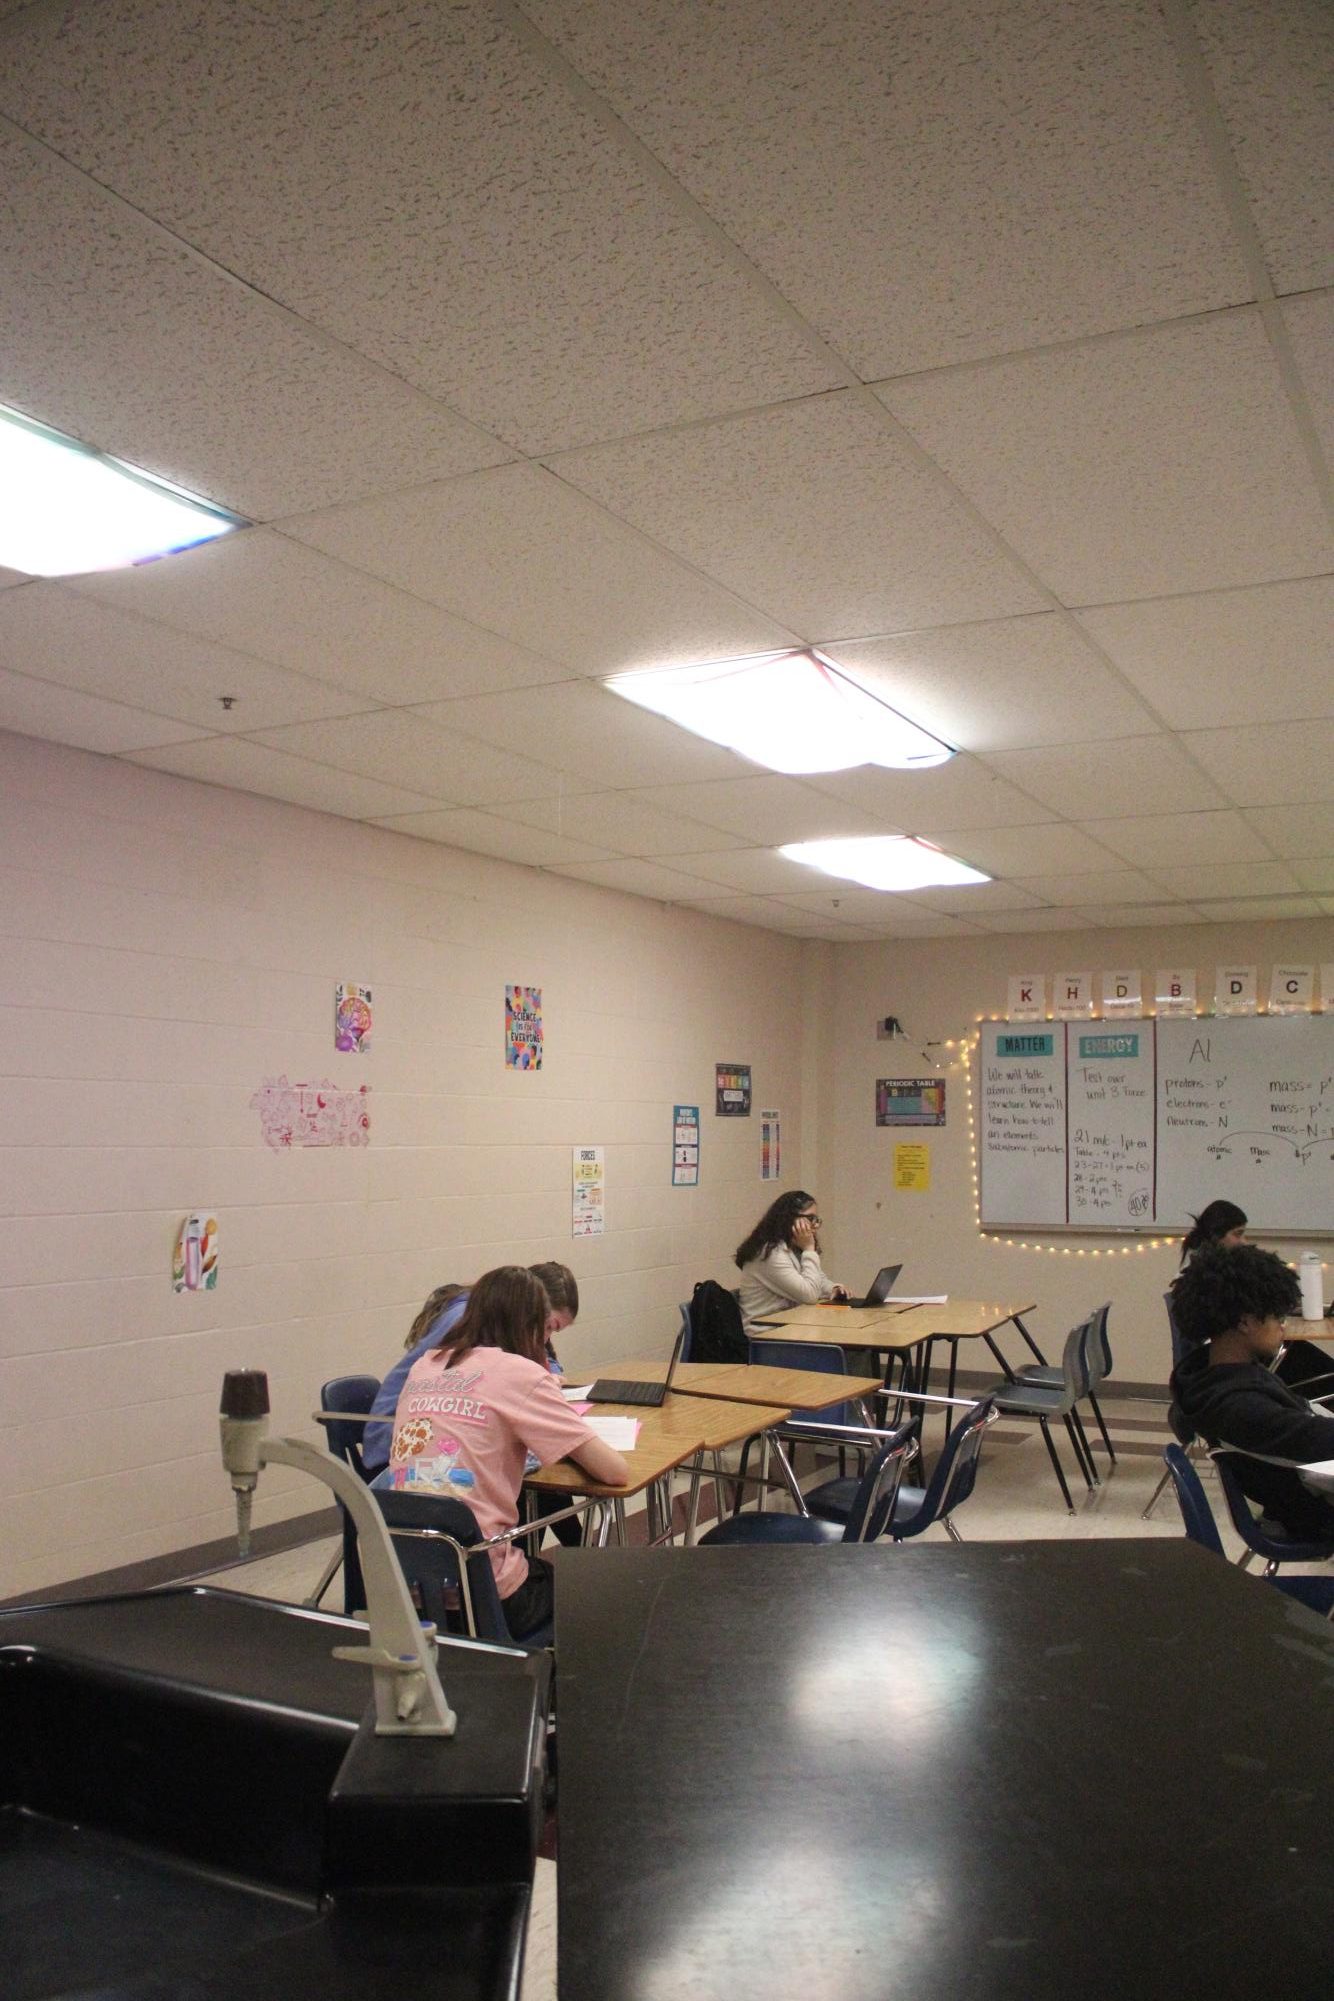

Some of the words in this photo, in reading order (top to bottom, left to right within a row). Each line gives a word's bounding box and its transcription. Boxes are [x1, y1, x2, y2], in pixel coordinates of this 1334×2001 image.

[1067, 986, 1079, 1000] H
[1116, 985, 1128, 998] D
[1170, 983, 1182, 997] B
[1230, 980, 1243, 994] D
[1286, 979, 1299, 994] C
[1020, 988, 1033, 1002] K
[513, 1011, 537, 1023] SCIENCE
[511, 1032, 541, 1043] EVERYONE
[1004, 1036, 1045, 1053] MATTER
[1085, 1038, 1134, 1055] ENERGY
[1189, 1038, 1211, 1064] Al
[1006, 1069, 1021, 1080] will
[1025, 1068, 1044, 1080] talk
[1076, 1066, 1102, 1083] Test
[886, 1080, 915, 1088] PERIODIC
[986, 1085, 1016, 1095] atomic
[1020, 1083, 1046, 1099] theory
[1086, 1087, 1106, 1100] unit
[1029, 1099, 1042, 1109] We
[1045, 1099, 1063, 1109] will
[988, 1113, 1009, 1125] learn
[1012, 1115, 1029, 1125] how
[1041, 1116, 1054, 1126] tell
[1218, 1115, 1228, 1128] N
[408, 1396, 487, 1420] COWGIRL
